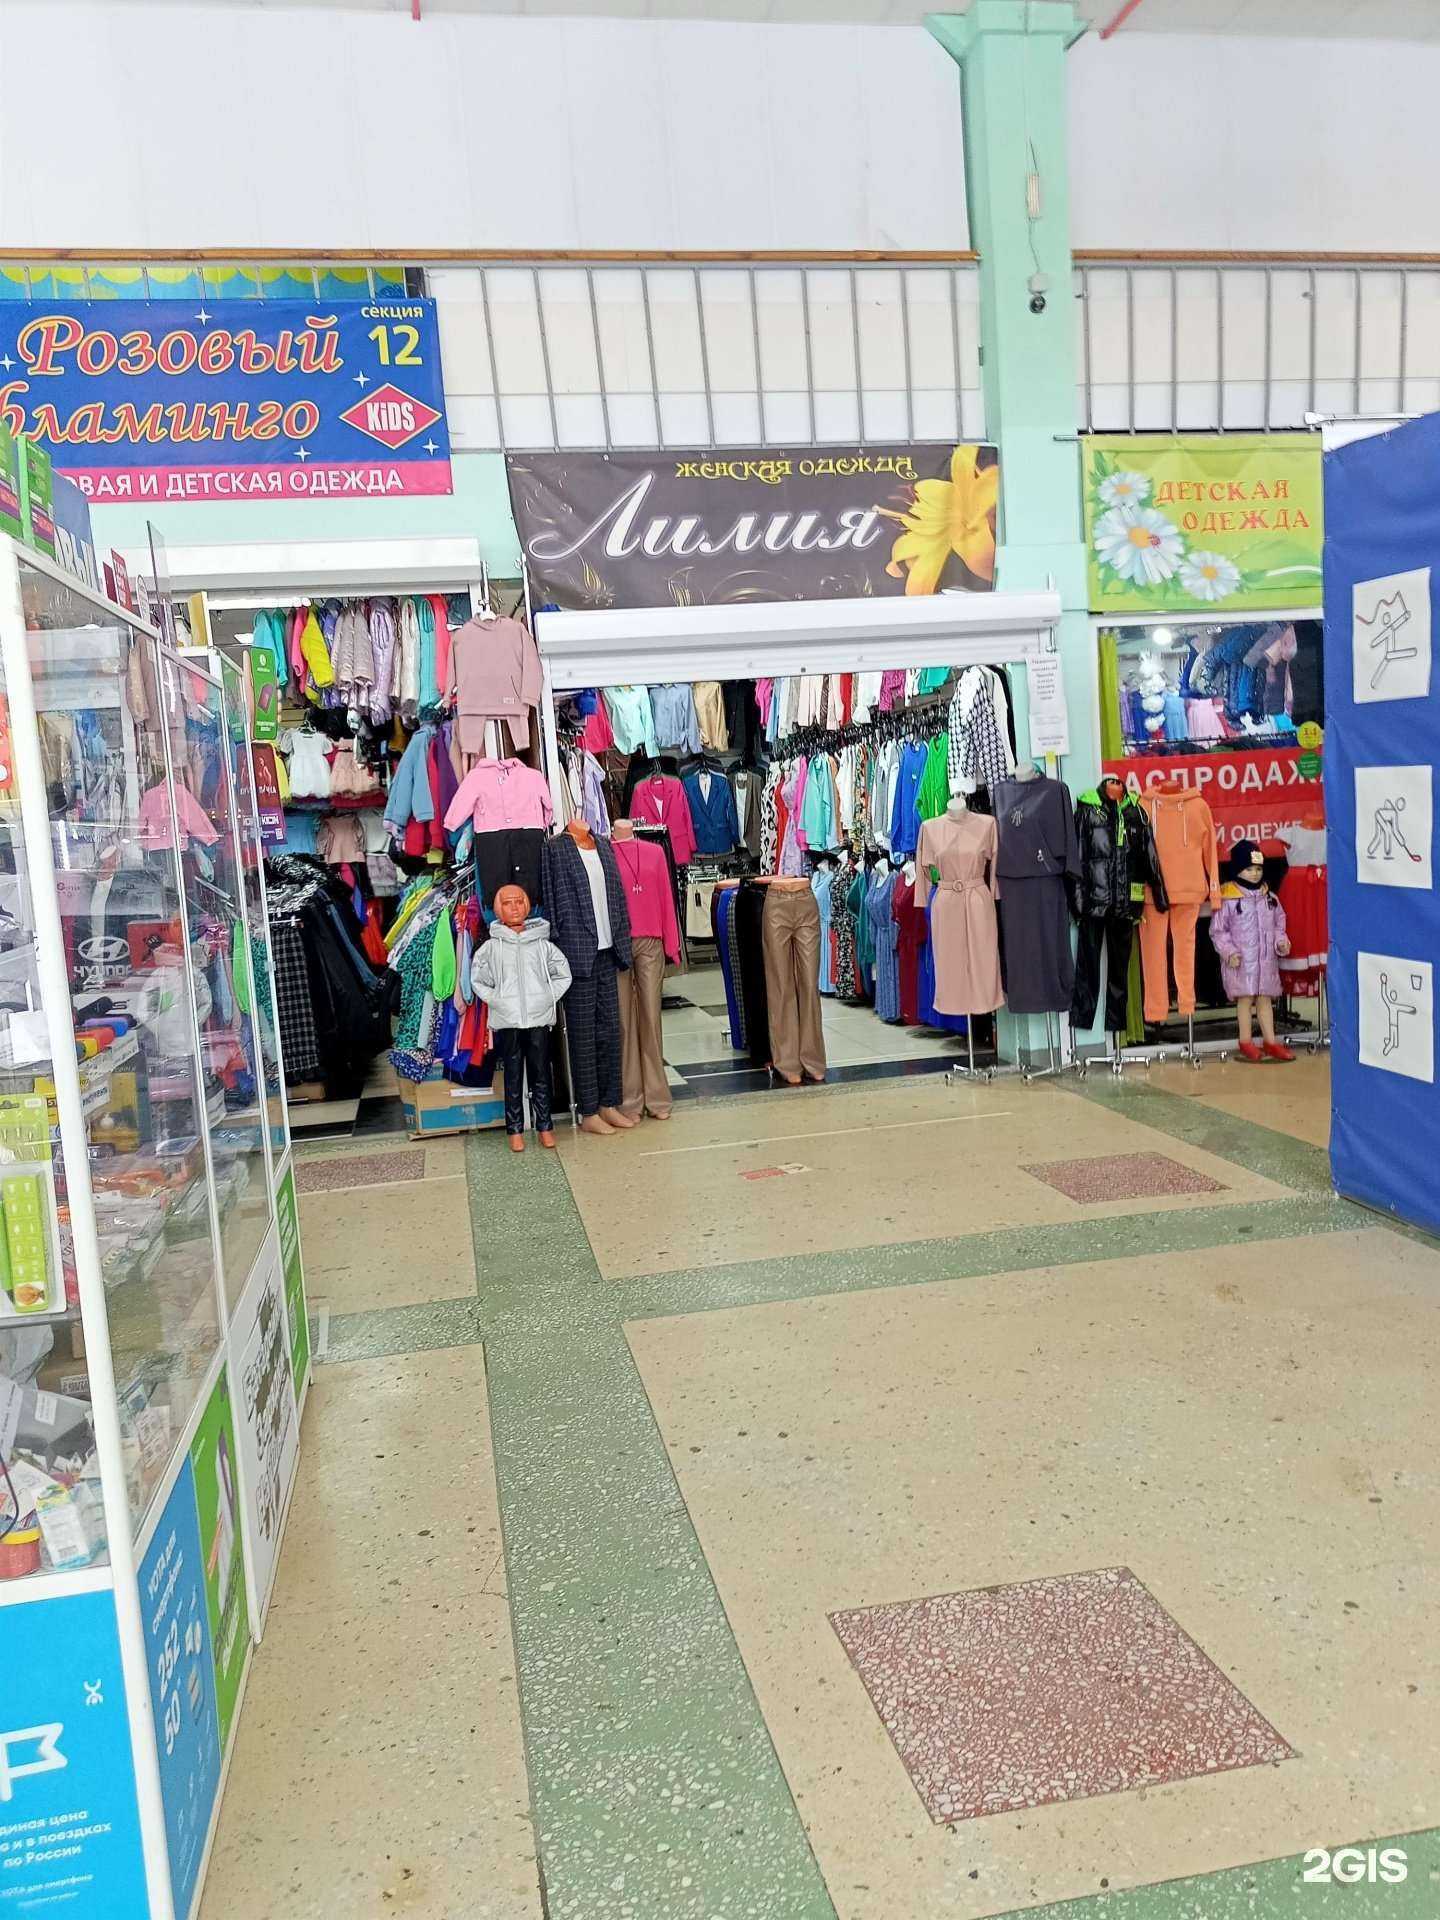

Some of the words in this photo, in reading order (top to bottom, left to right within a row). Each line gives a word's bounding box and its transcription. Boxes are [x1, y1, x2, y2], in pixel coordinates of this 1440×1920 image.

[361, 305, 424, 320] секция
[17, 314, 345, 376] Розовый
[368, 325, 423, 366] 12
[139, 473, 159, 495] И
[165, 470, 283, 498] ДЕТСКАЯ
[289, 467, 405, 493] ОДЕЖДА
[675, 459, 793, 484] ЖЕНСКАЯ
[799, 456, 918, 480] ОДЕЖДА
[1156, 479, 1290, 504] ДЕТСКАЯ
[527, 471, 884, 562] Лилия
[1182, 508, 1310, 534] ОДЕЖДА
[1103, 760, 1324, 798] АСПРОДАЖ
[0, 1819, 46, 1836] диная
[49, 1810, 88, 1826] цена
[13, 1839, 22, 1850] и
[26, 1837, 35, 1847] в
[39, 1823, 112, 1844] поездках
[4, 1857, 23, 1868] по
[26, 1845, 82, 1864] России
